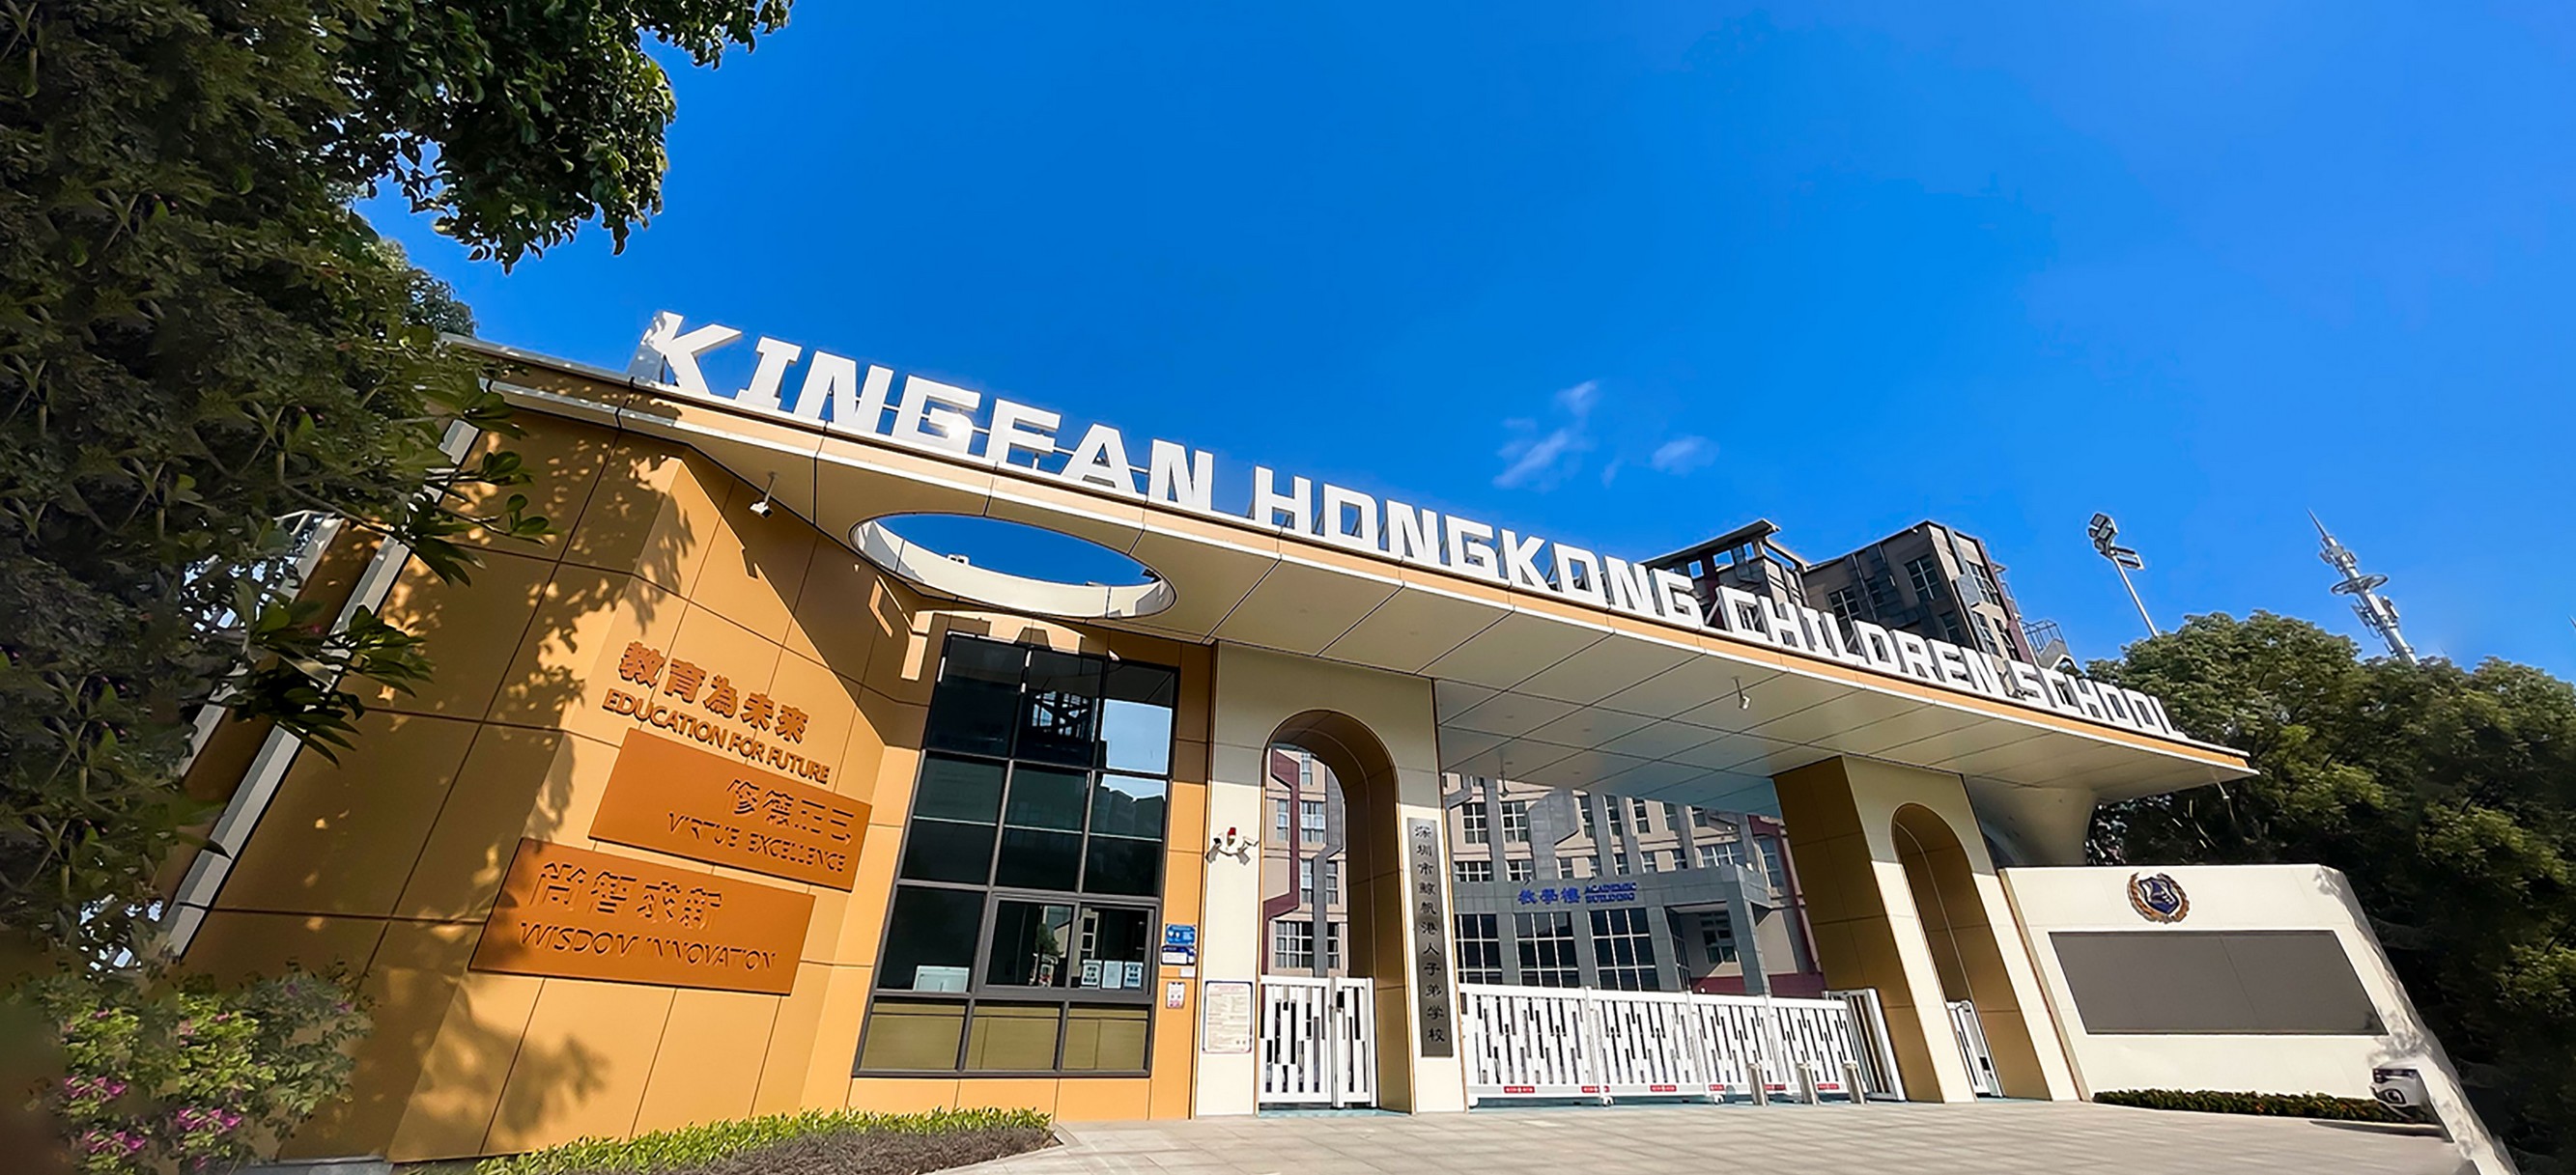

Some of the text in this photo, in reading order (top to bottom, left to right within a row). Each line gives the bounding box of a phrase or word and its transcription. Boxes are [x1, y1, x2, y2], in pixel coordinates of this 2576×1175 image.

[628, 310, 2189, 741] KINGFAN HONGKONG CHILDREN SCHOOL
[602, 687, 831, 785] EDUCATION FOR FUTURE
[668, 812, 847, 872] VIRTUE EXCELLENCE
[529, 862, 723, 931] 尚智求新
[1584, 882, 1637, 894] ACADEMIC
[1585, 892, 1635, 904] BUILDING
[520, 922, 777, 970] WISDOM INNOVATION
